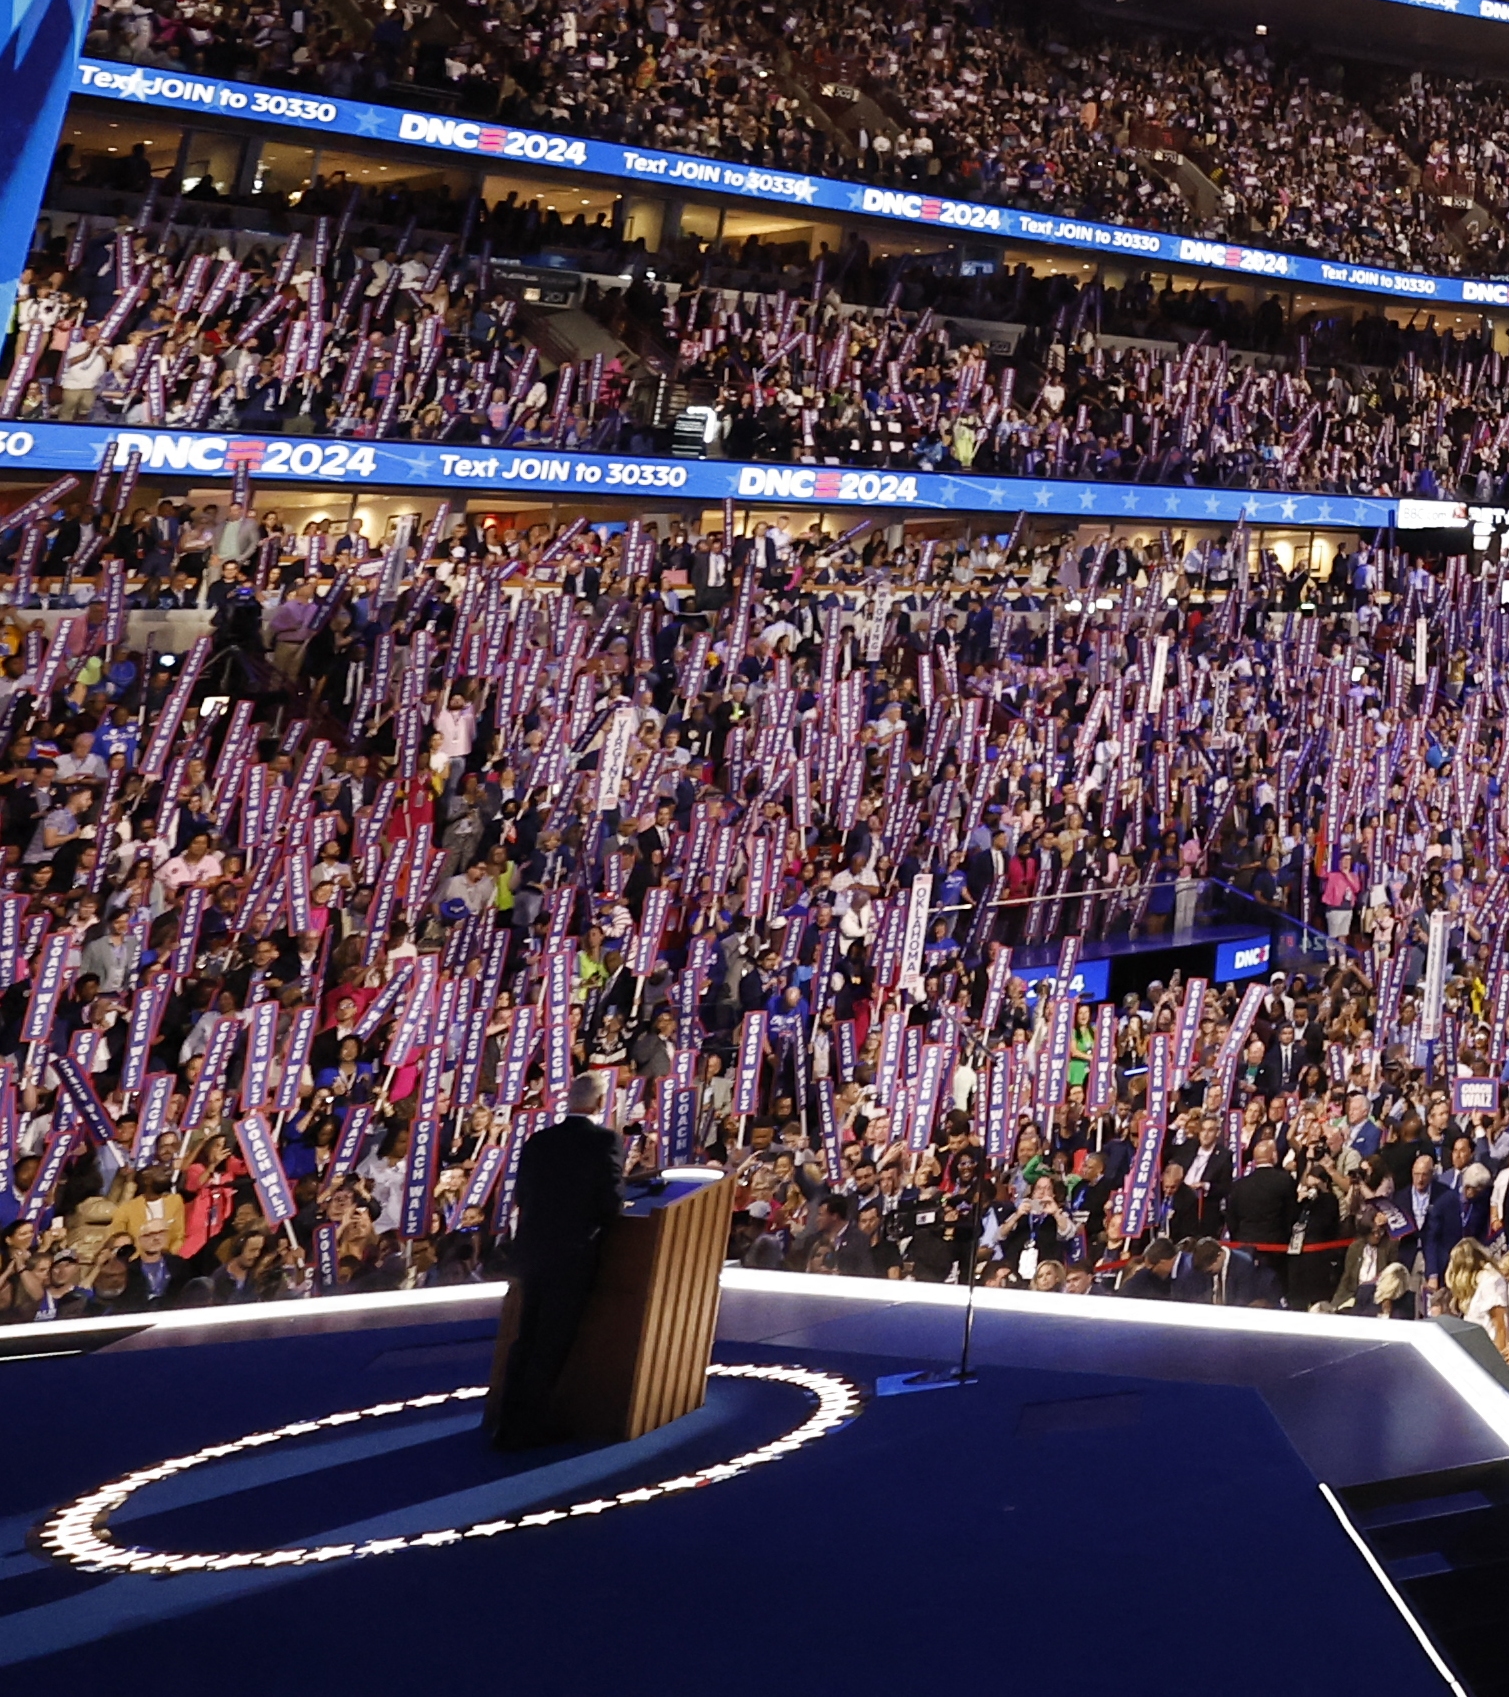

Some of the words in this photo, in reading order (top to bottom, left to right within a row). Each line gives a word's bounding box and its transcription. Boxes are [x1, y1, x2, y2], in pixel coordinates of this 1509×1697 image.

[79, 65, 139, 94] Text
[144, 78, 216, 103] JOIN
[220, 86, 248, 108] to
[251, 93, 337, 122] 30330
[399, 113, 480, 149] DNC
[503, 132, 587, 165] 2024
[112, 433, 228, 470] DNC
[261, 441, 377, 476] 2024
[440, 454, 500, 478] Text
[502, 458, 570, 482] JOIN
[574, 461, 601, 483] to
[606, 463, 687, 487] 30330
[739, 468, 816, 498] DNC
[839, 473, 918, 502] 2024
[606, 720, 628, 796] VIRGINIA
[907, 888, 927, 972] OKLAHOMA
[42, 935, 65, 989] COACH
[32, 992, 53, 1036] WALZ
[744, 1014, 760, 1065] COACH
[739, 1068, 756, 1111] WALZ
[919, 1046, 938, 1100] COACH
[1461, 1083, 1493, 1093] COACH
[1461, 1093, 1493, 1107] WALZ
[411, 1120, 430, 1181] COACH
[912, 1104, 931, 1149] WALZ
[243, 1118, 272, 1172] COACH
[260, 1173, 288, 1217] WALZ
[405, 1184, 425, 1234] WALZ
